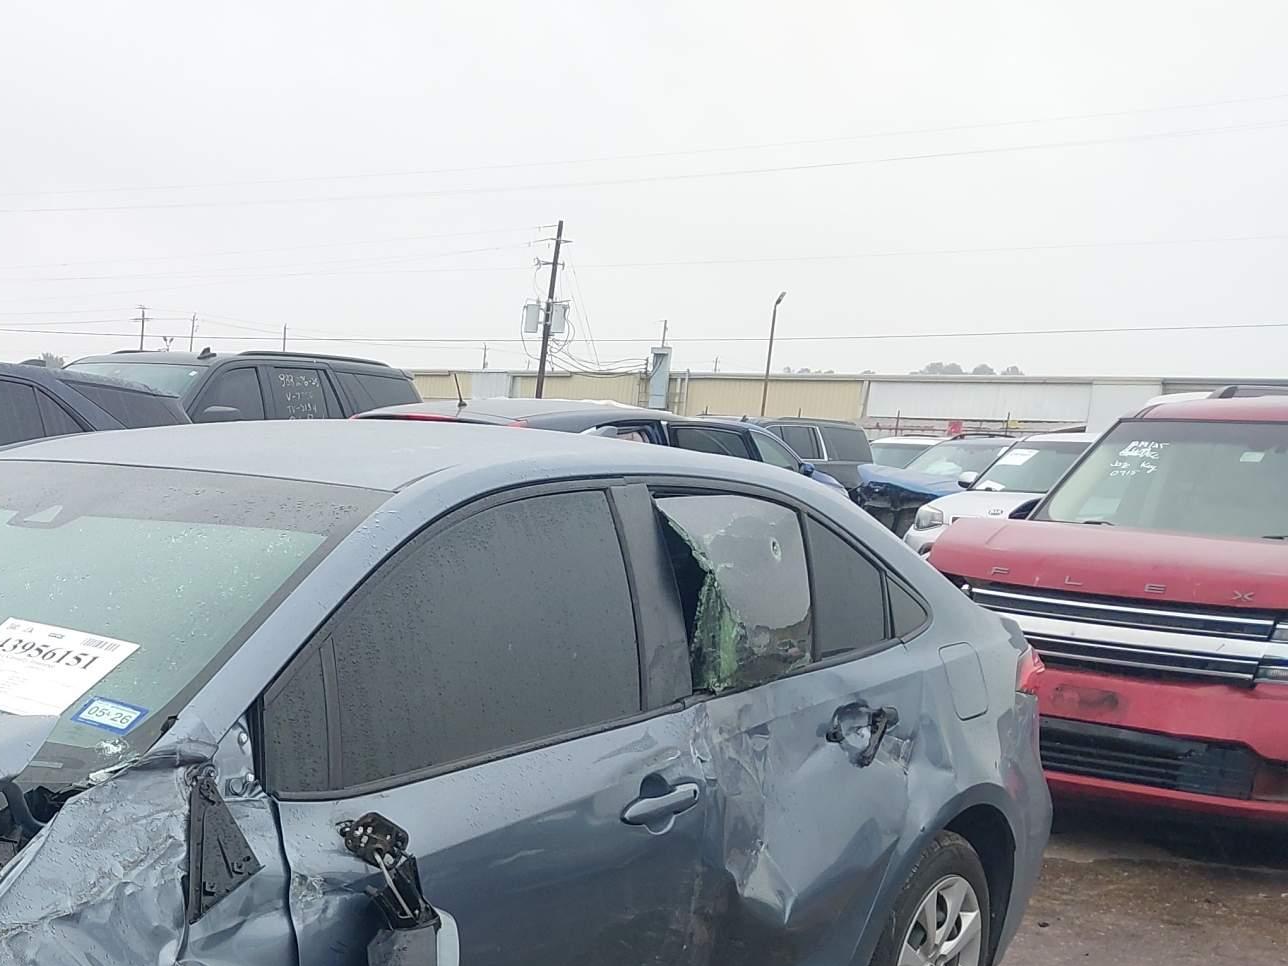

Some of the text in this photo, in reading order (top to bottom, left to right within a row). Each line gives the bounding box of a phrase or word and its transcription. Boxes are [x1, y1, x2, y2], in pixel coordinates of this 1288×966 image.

[990, 566, 1255, 602] FLEX
[87, 705, 109, 718] 05
[110, 712, 132, 725] 26
